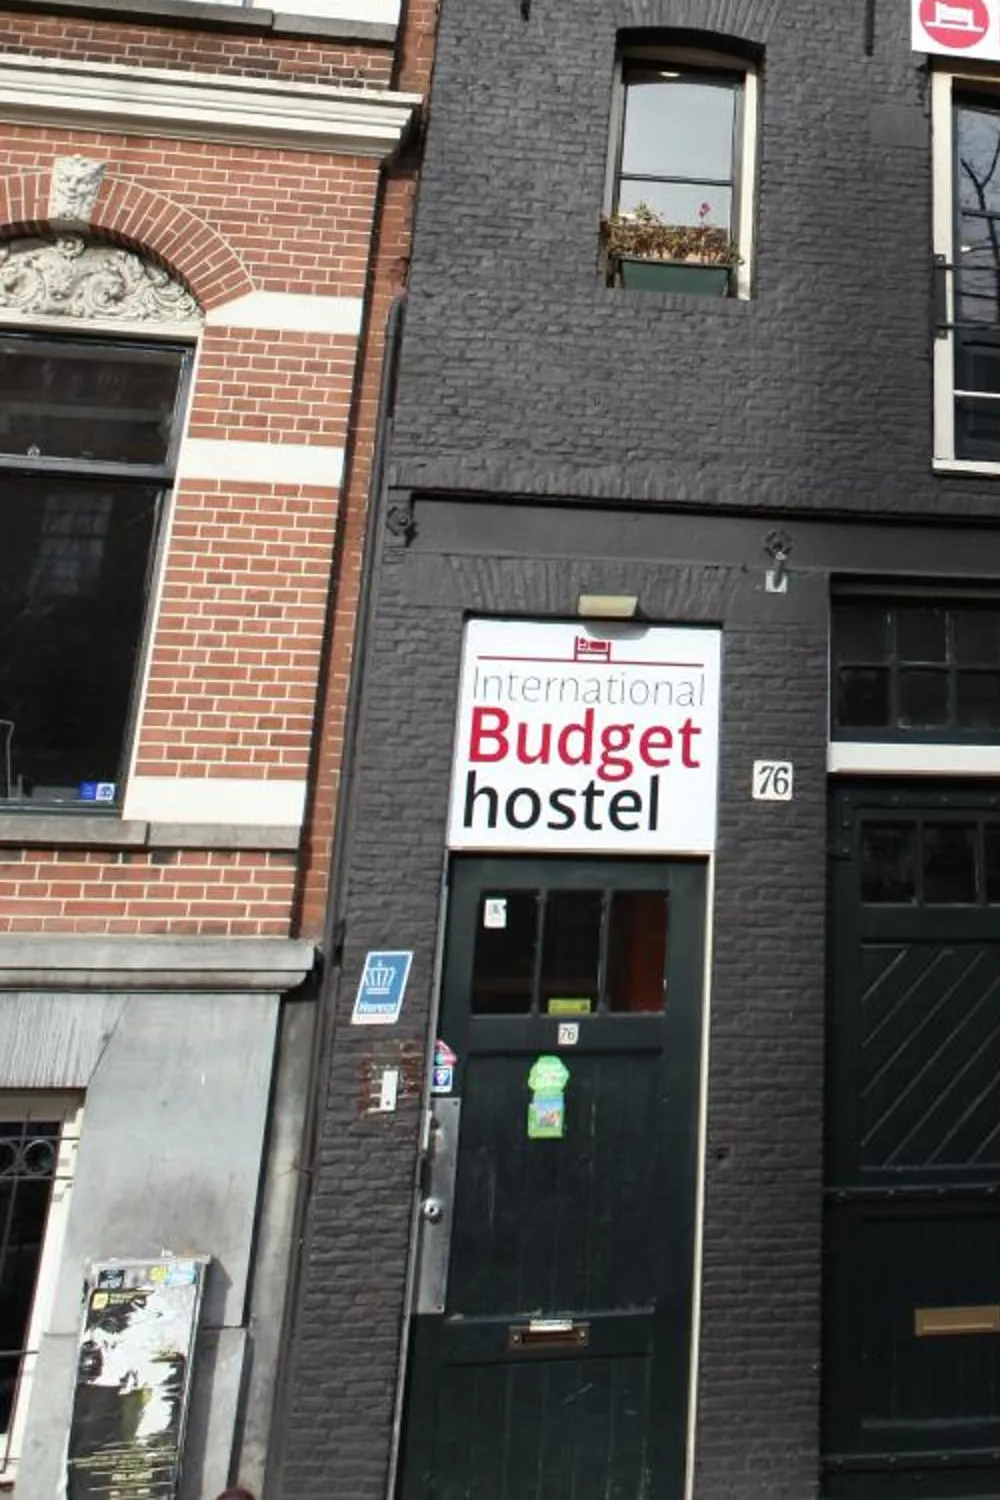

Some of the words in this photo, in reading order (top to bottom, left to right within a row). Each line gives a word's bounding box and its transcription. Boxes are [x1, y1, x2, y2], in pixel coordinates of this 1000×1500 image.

[472, 667, 705, 707] International
[468, 706, 702, 782] Budget
[463, 770, 659, 831] hostel
[757, 765, 789, 796] 76
